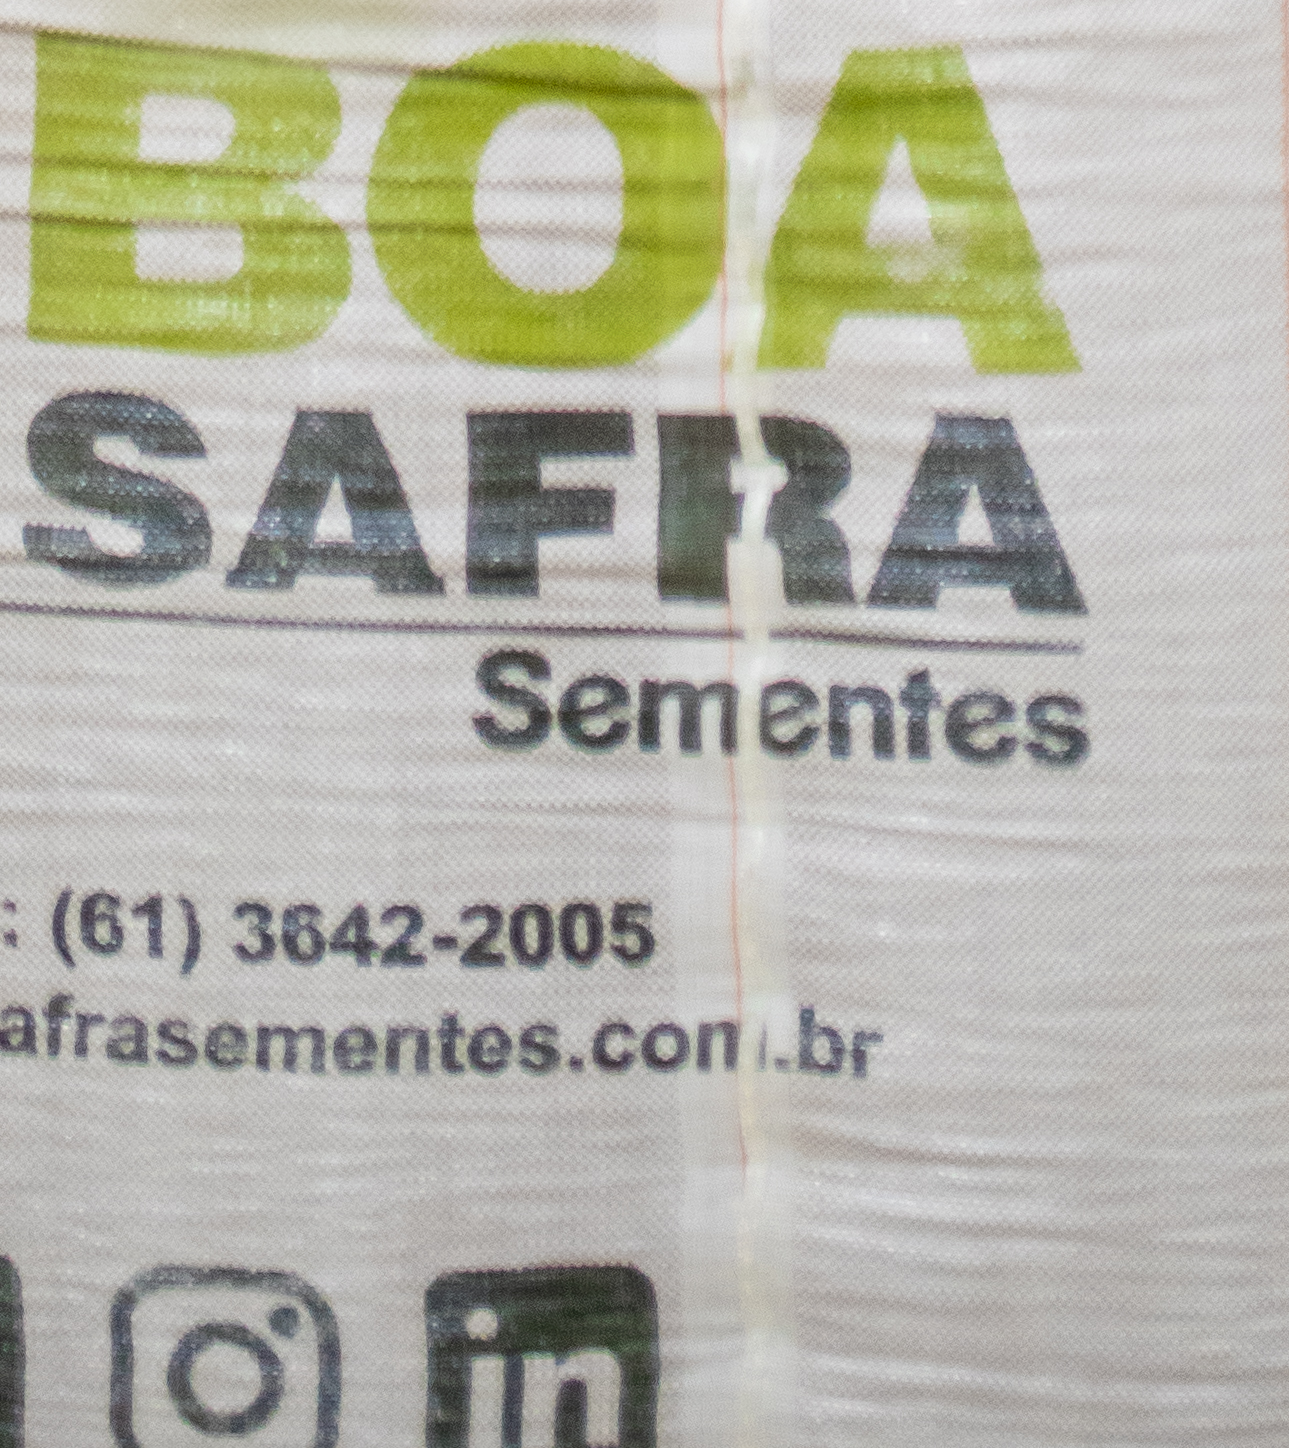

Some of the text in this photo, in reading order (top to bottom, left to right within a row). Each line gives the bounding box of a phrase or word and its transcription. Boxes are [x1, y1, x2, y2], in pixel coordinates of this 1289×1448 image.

[27, 28, 1083, 375] BOA
[21, 389, 1090, 615] SAFRA
[471, 648, 1092, 768] Sementes
[52, 884, 202, 976] (61)
[232, 901, 657, 969] 3642-2005
